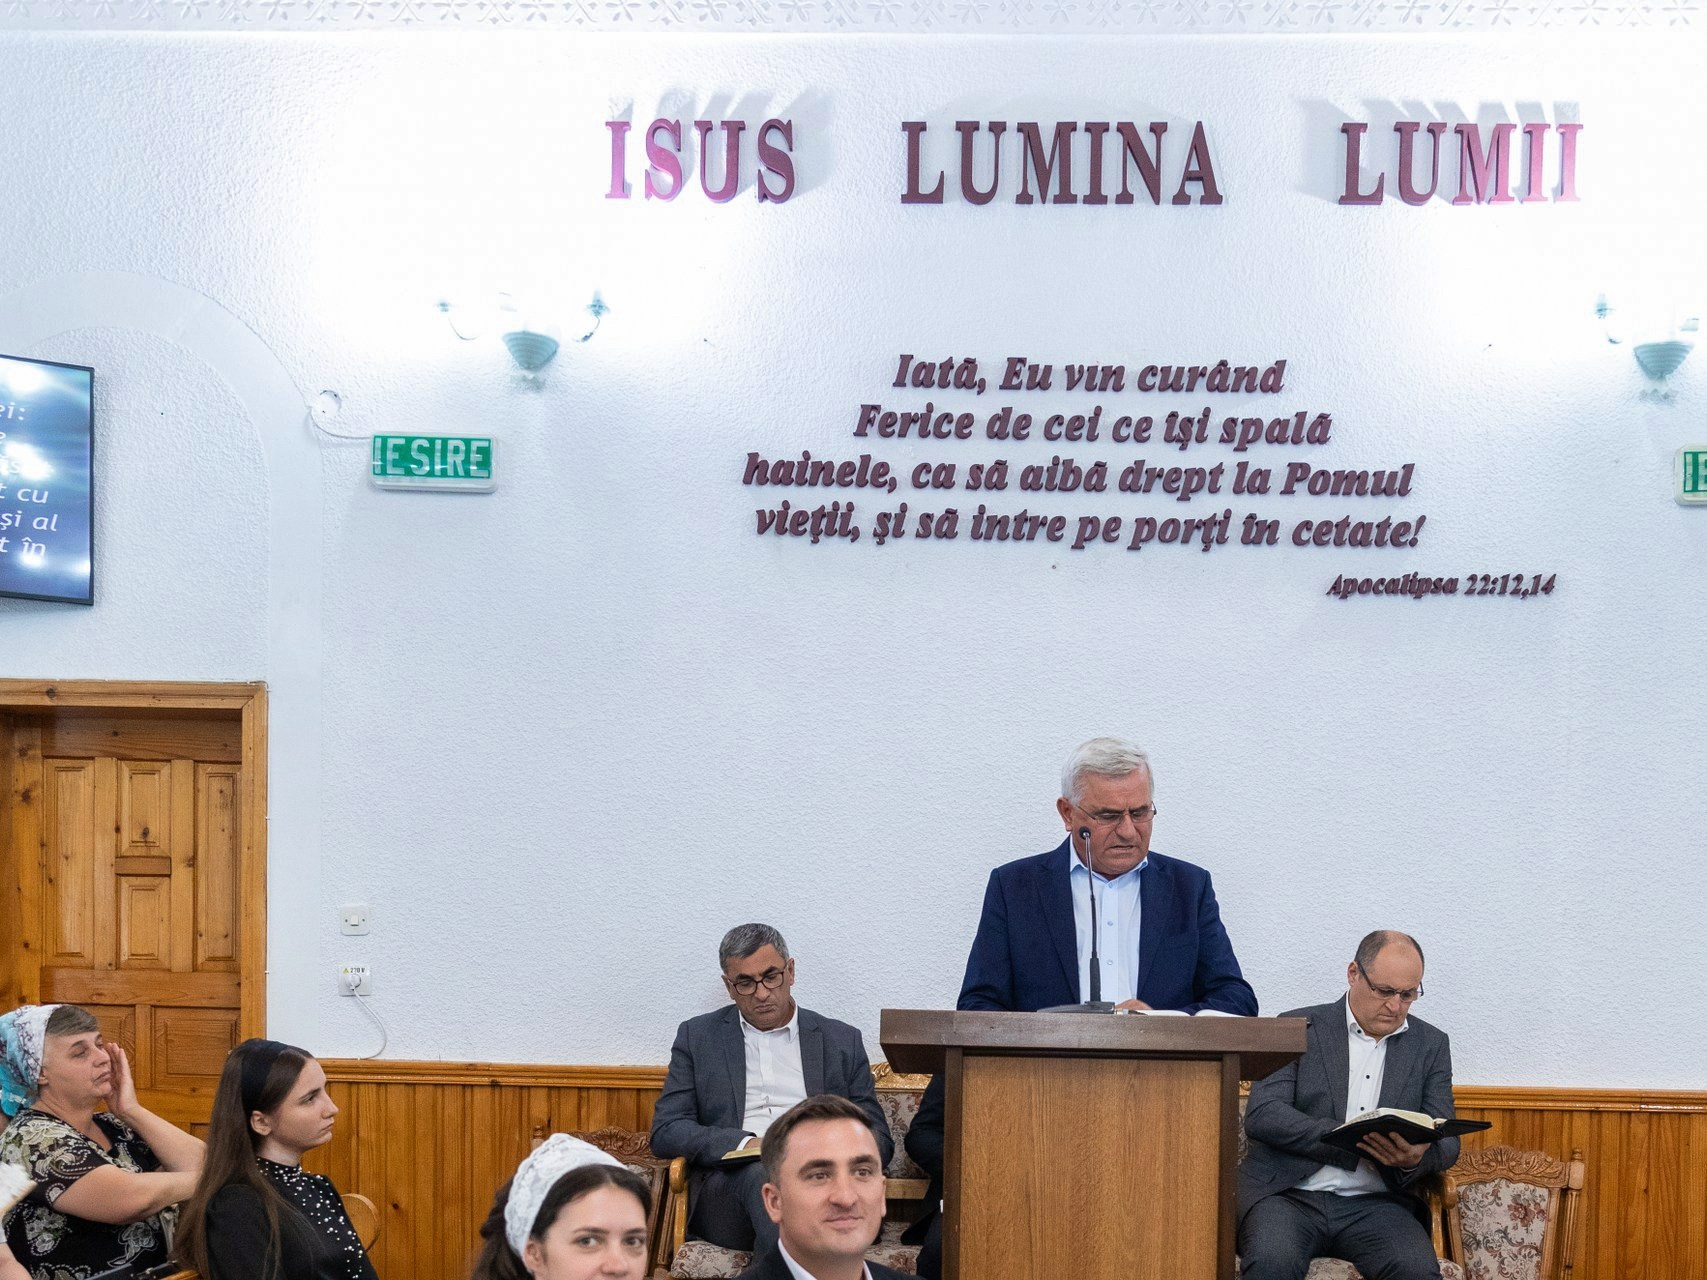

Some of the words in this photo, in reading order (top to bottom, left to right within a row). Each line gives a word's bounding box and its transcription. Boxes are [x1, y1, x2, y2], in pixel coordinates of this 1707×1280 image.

[605, 118, 795, 204] ISUS
[900, 120, 1224, 206] LUMINA
[1338, 121, 1584, 206] LUMII
[999, 356, 1053, 391] Eu
[1137, 359, 1287, 394] curând
[852, 402, 975, 440] Ferice
[985, 406, 1033, 441] de
[1043, 405, 1103, 443] cei
[1111, 415, 1154, 444] ce
[742, 449, 898, 494] hainele,
[911, 462, 957, 490] ca
[1118, 459, 1225, 502] drept
[1232, 460, 1272, 496] la
[1279, 462, 1416, 498] Pomul
[17, 488, 48, 504] cu
[32, 513, 58, 532] al
[970, 503, 1067, 543] intre
[1070, 515, 1123, 551] pe
[1240, 512, 1281, 546] în
[1290, 514, 1428, 548] cetate!
[1325, 571, 1459, 600] Apocalipsa
[1463, 573, 1557, 600] 22:12,14
